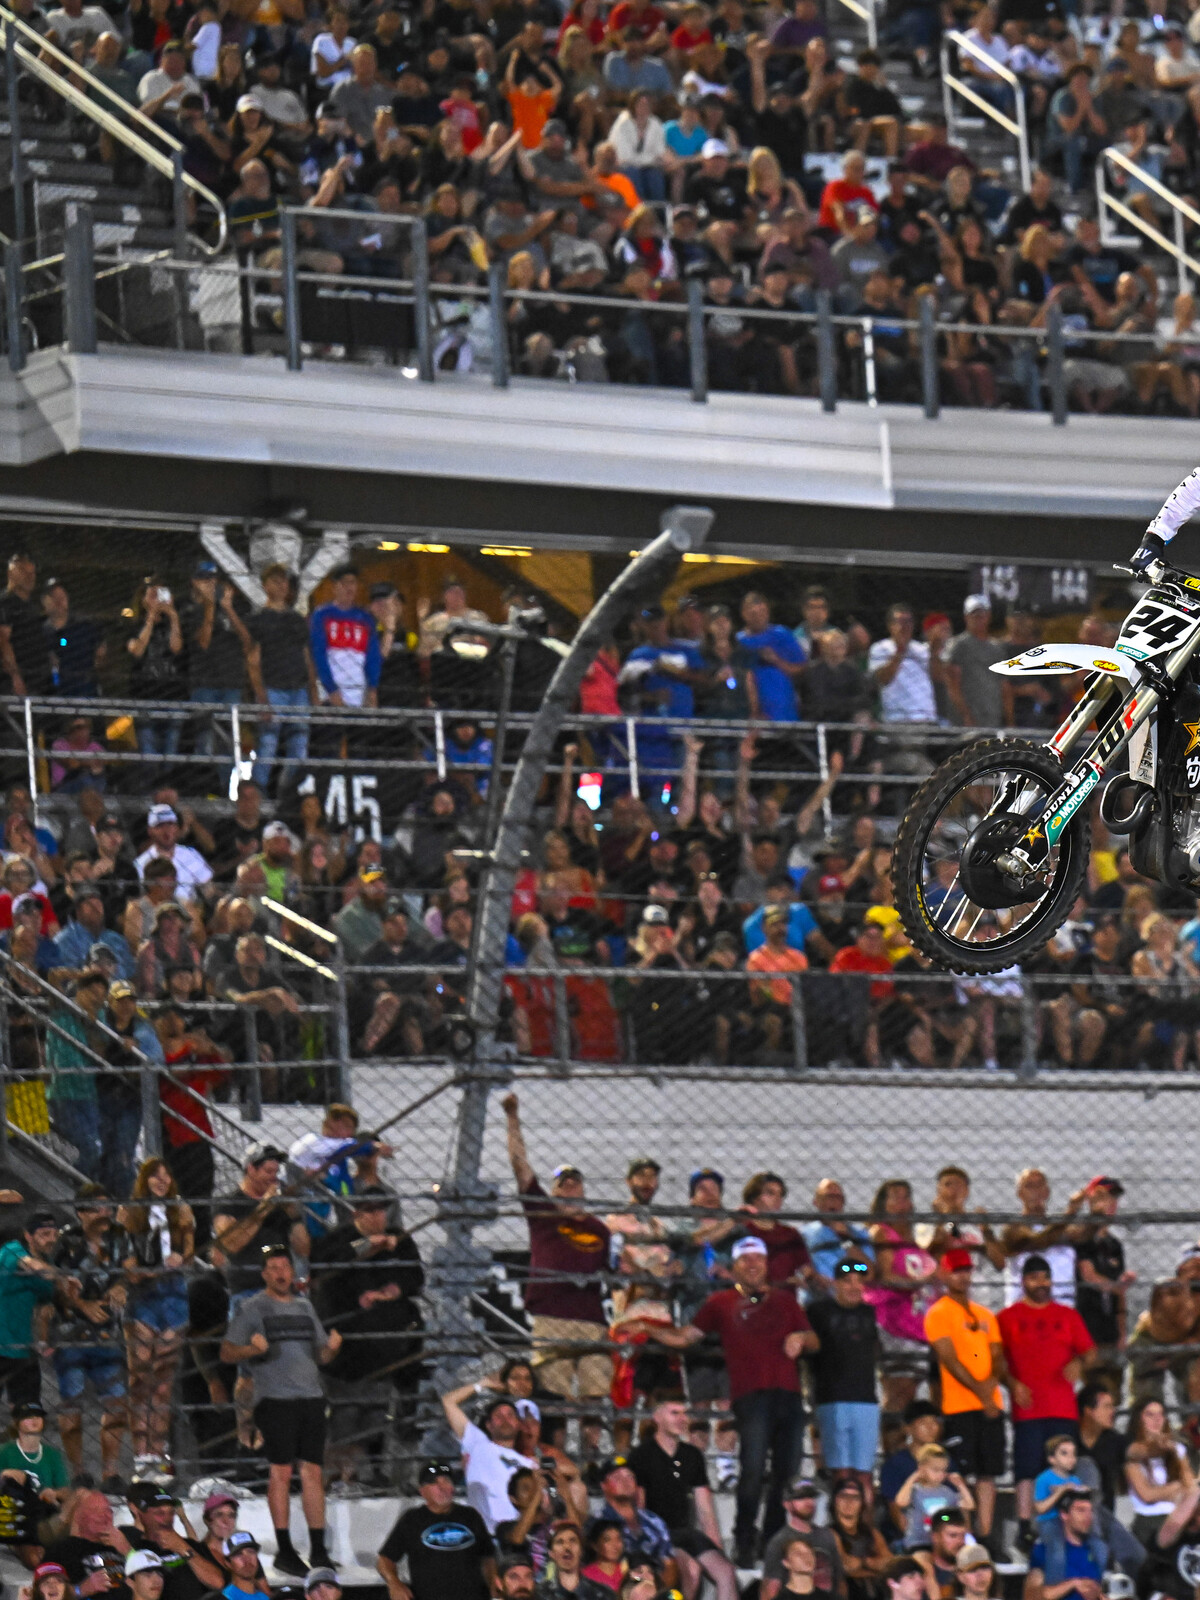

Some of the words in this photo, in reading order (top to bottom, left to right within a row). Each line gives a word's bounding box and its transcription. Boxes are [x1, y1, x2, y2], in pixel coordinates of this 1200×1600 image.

[1120, 604, 1192, 650] 24
[1042, 767, 1087, 822] DUNLP
[1058, 774, 1099, 819] MOTOREX
